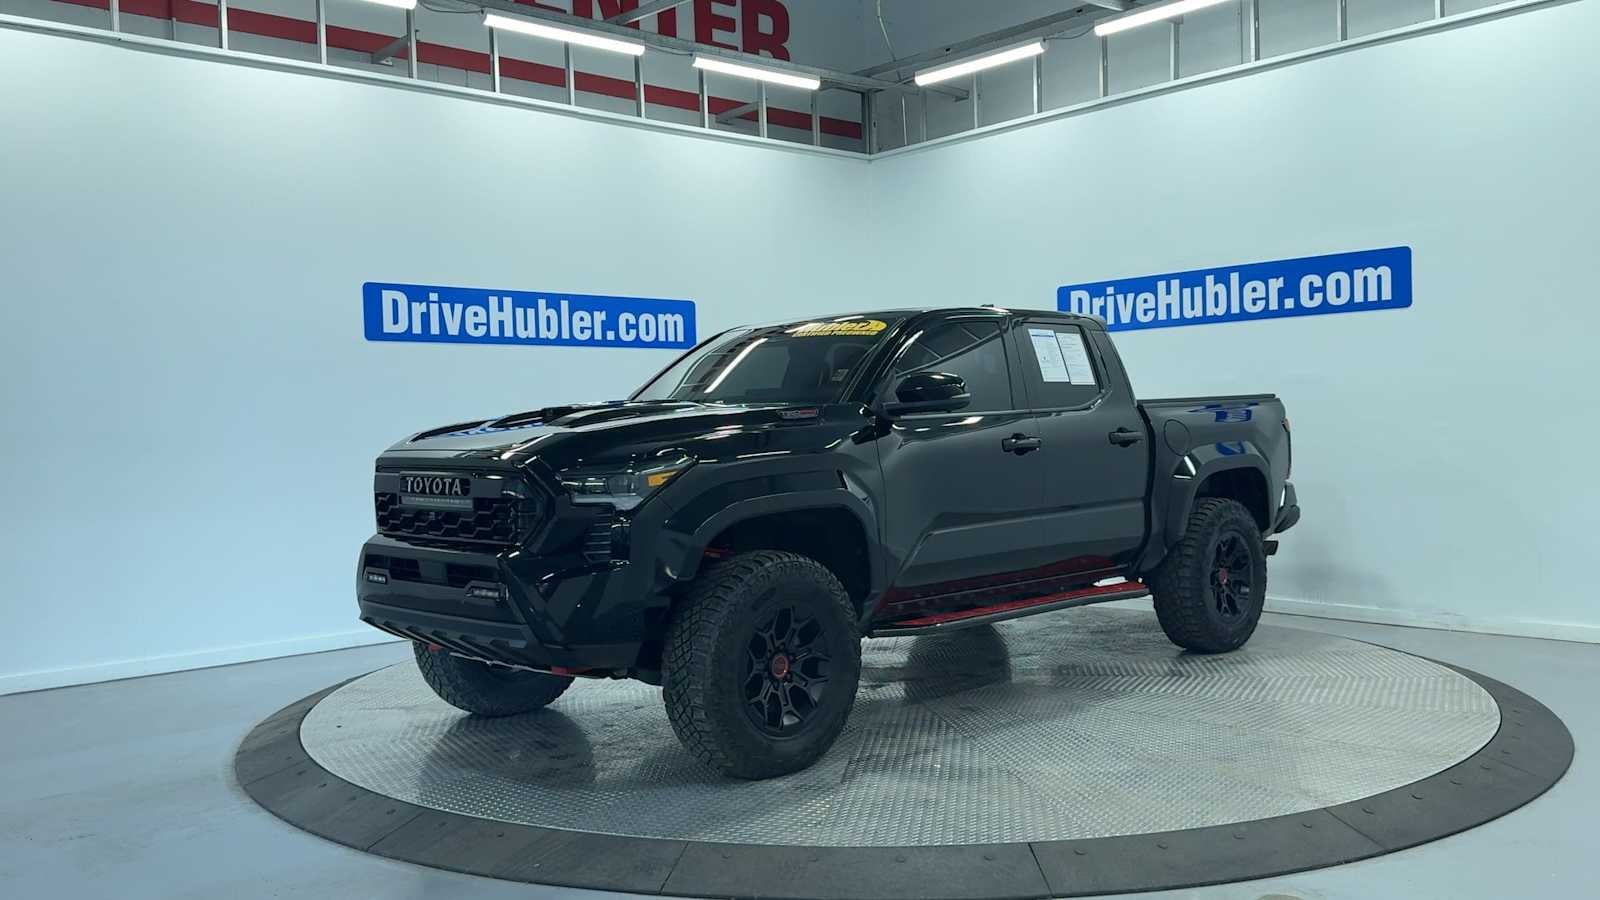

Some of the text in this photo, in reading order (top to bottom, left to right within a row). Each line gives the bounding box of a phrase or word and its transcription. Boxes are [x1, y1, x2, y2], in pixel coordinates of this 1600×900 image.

[381, 289, 685, 342] DriveHubler.com
[1070, 265, 1392, 325] DriveHubler.com
[406, 476, 462, 495] TOYOTA
